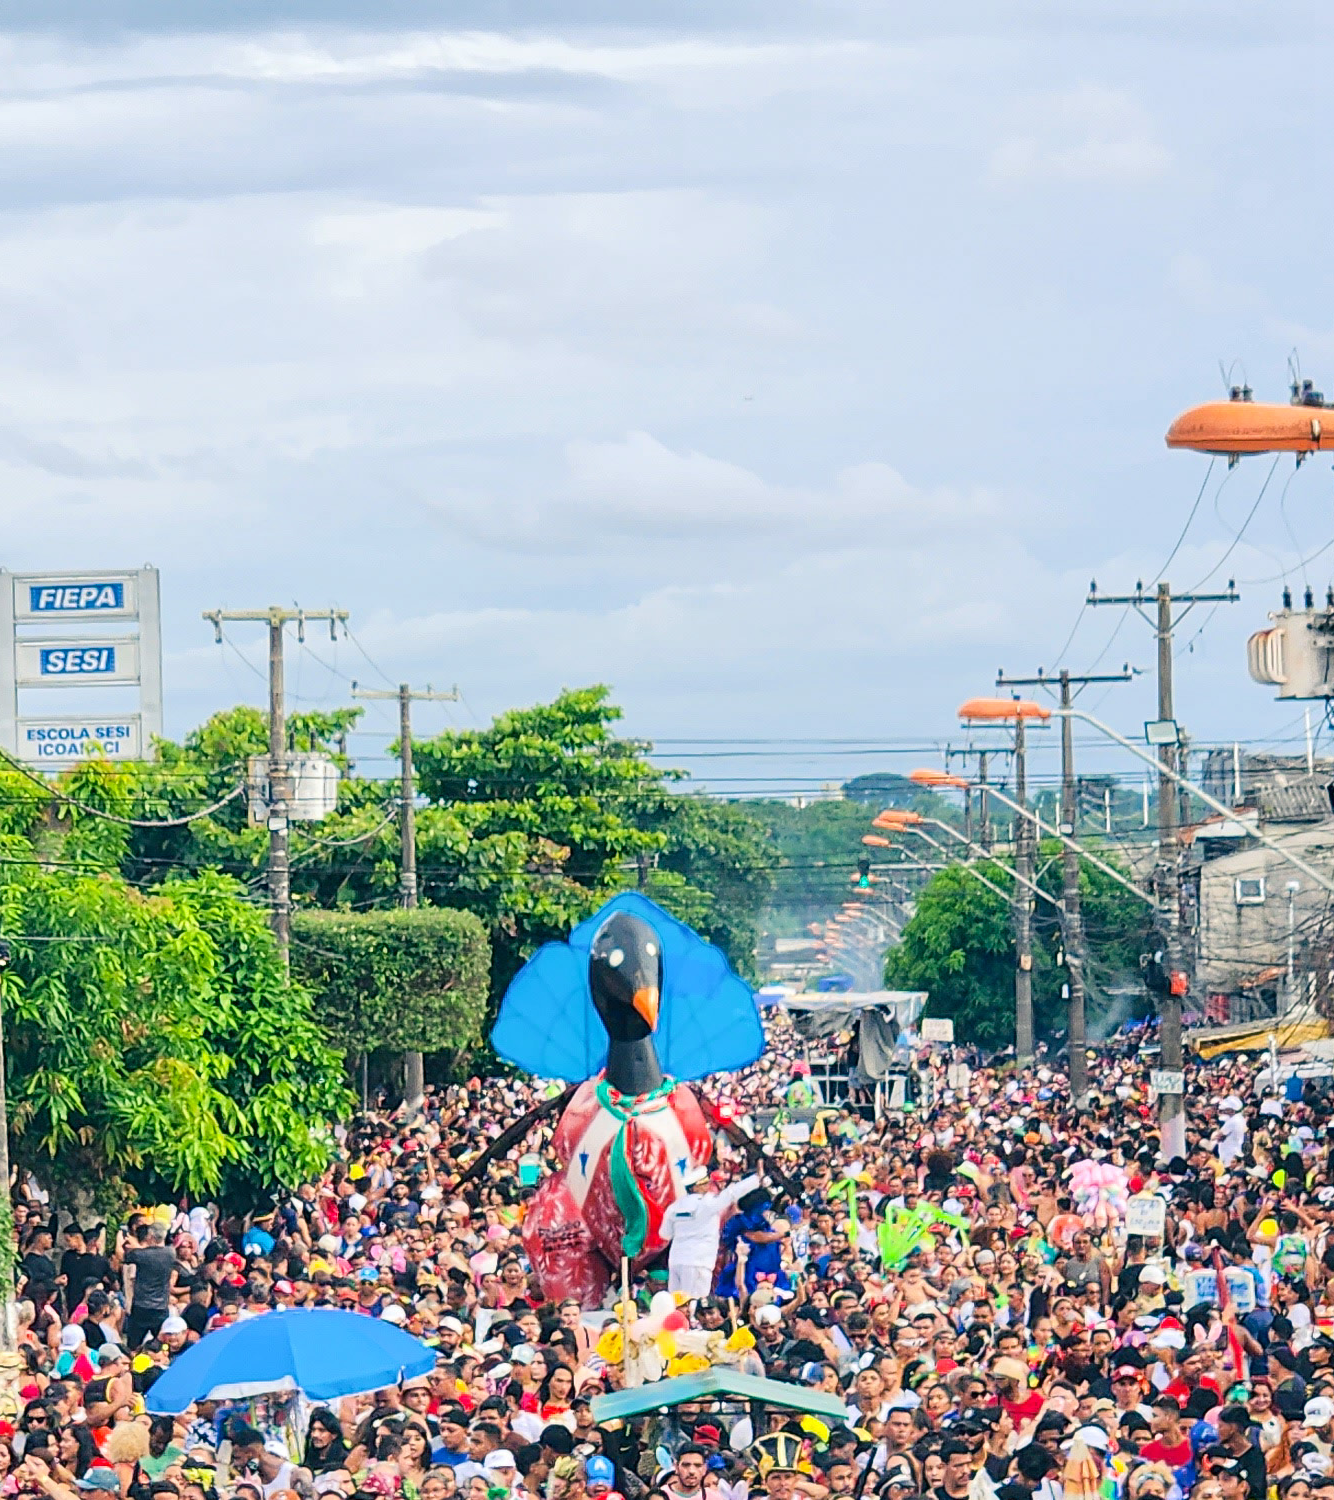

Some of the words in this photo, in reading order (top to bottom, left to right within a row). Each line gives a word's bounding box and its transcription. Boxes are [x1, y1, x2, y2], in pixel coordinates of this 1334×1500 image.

[38, 586, 117, 609] FIEPA
[45, 649, 109, 673] SESI
[26, 727, 90, 742] ESCOLA
[94, 726, 130, 739] SESI
[38, 741, 120, 756] ICOACI
